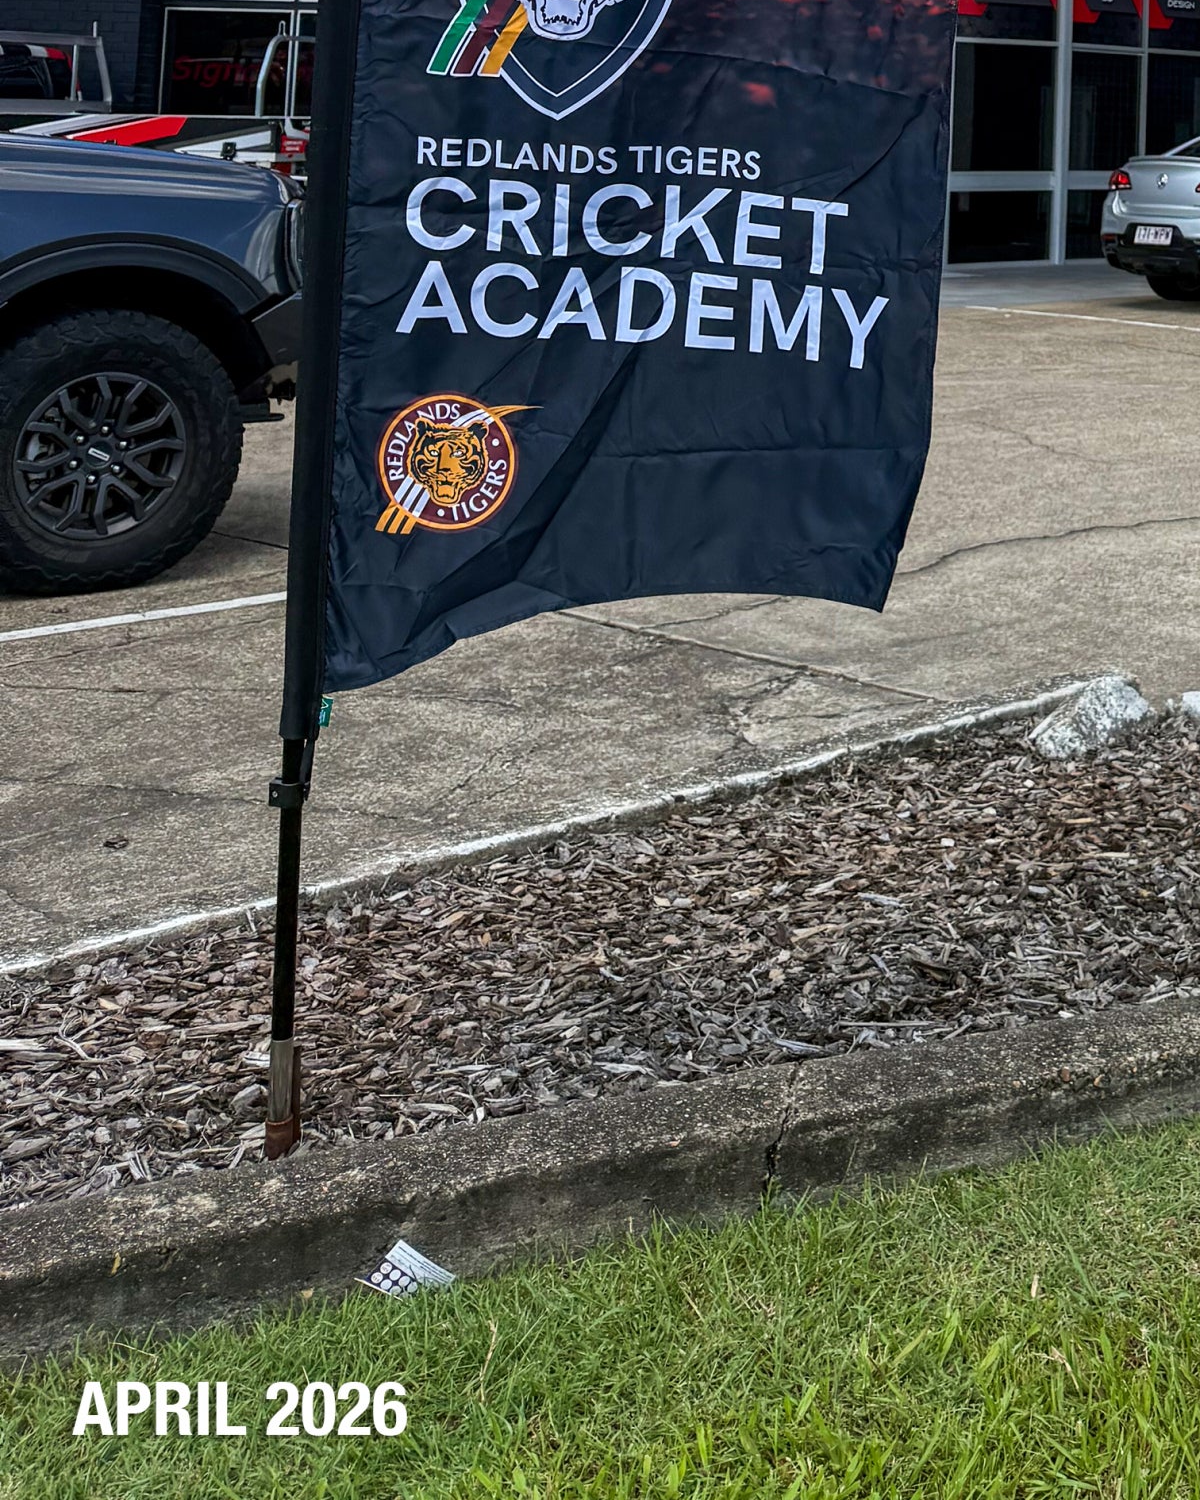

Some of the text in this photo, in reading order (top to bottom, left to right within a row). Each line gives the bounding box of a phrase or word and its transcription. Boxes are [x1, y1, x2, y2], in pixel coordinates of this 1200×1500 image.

[416, 136, 762, 180] REDLANDS TIGERS
[405, 176, 849, 274] CRICKET
[396, 260, 890, 369] ACADEMY
[387, 403, 461, 482] REDLANDS
[450, 458, 508, 522] TIGERS
